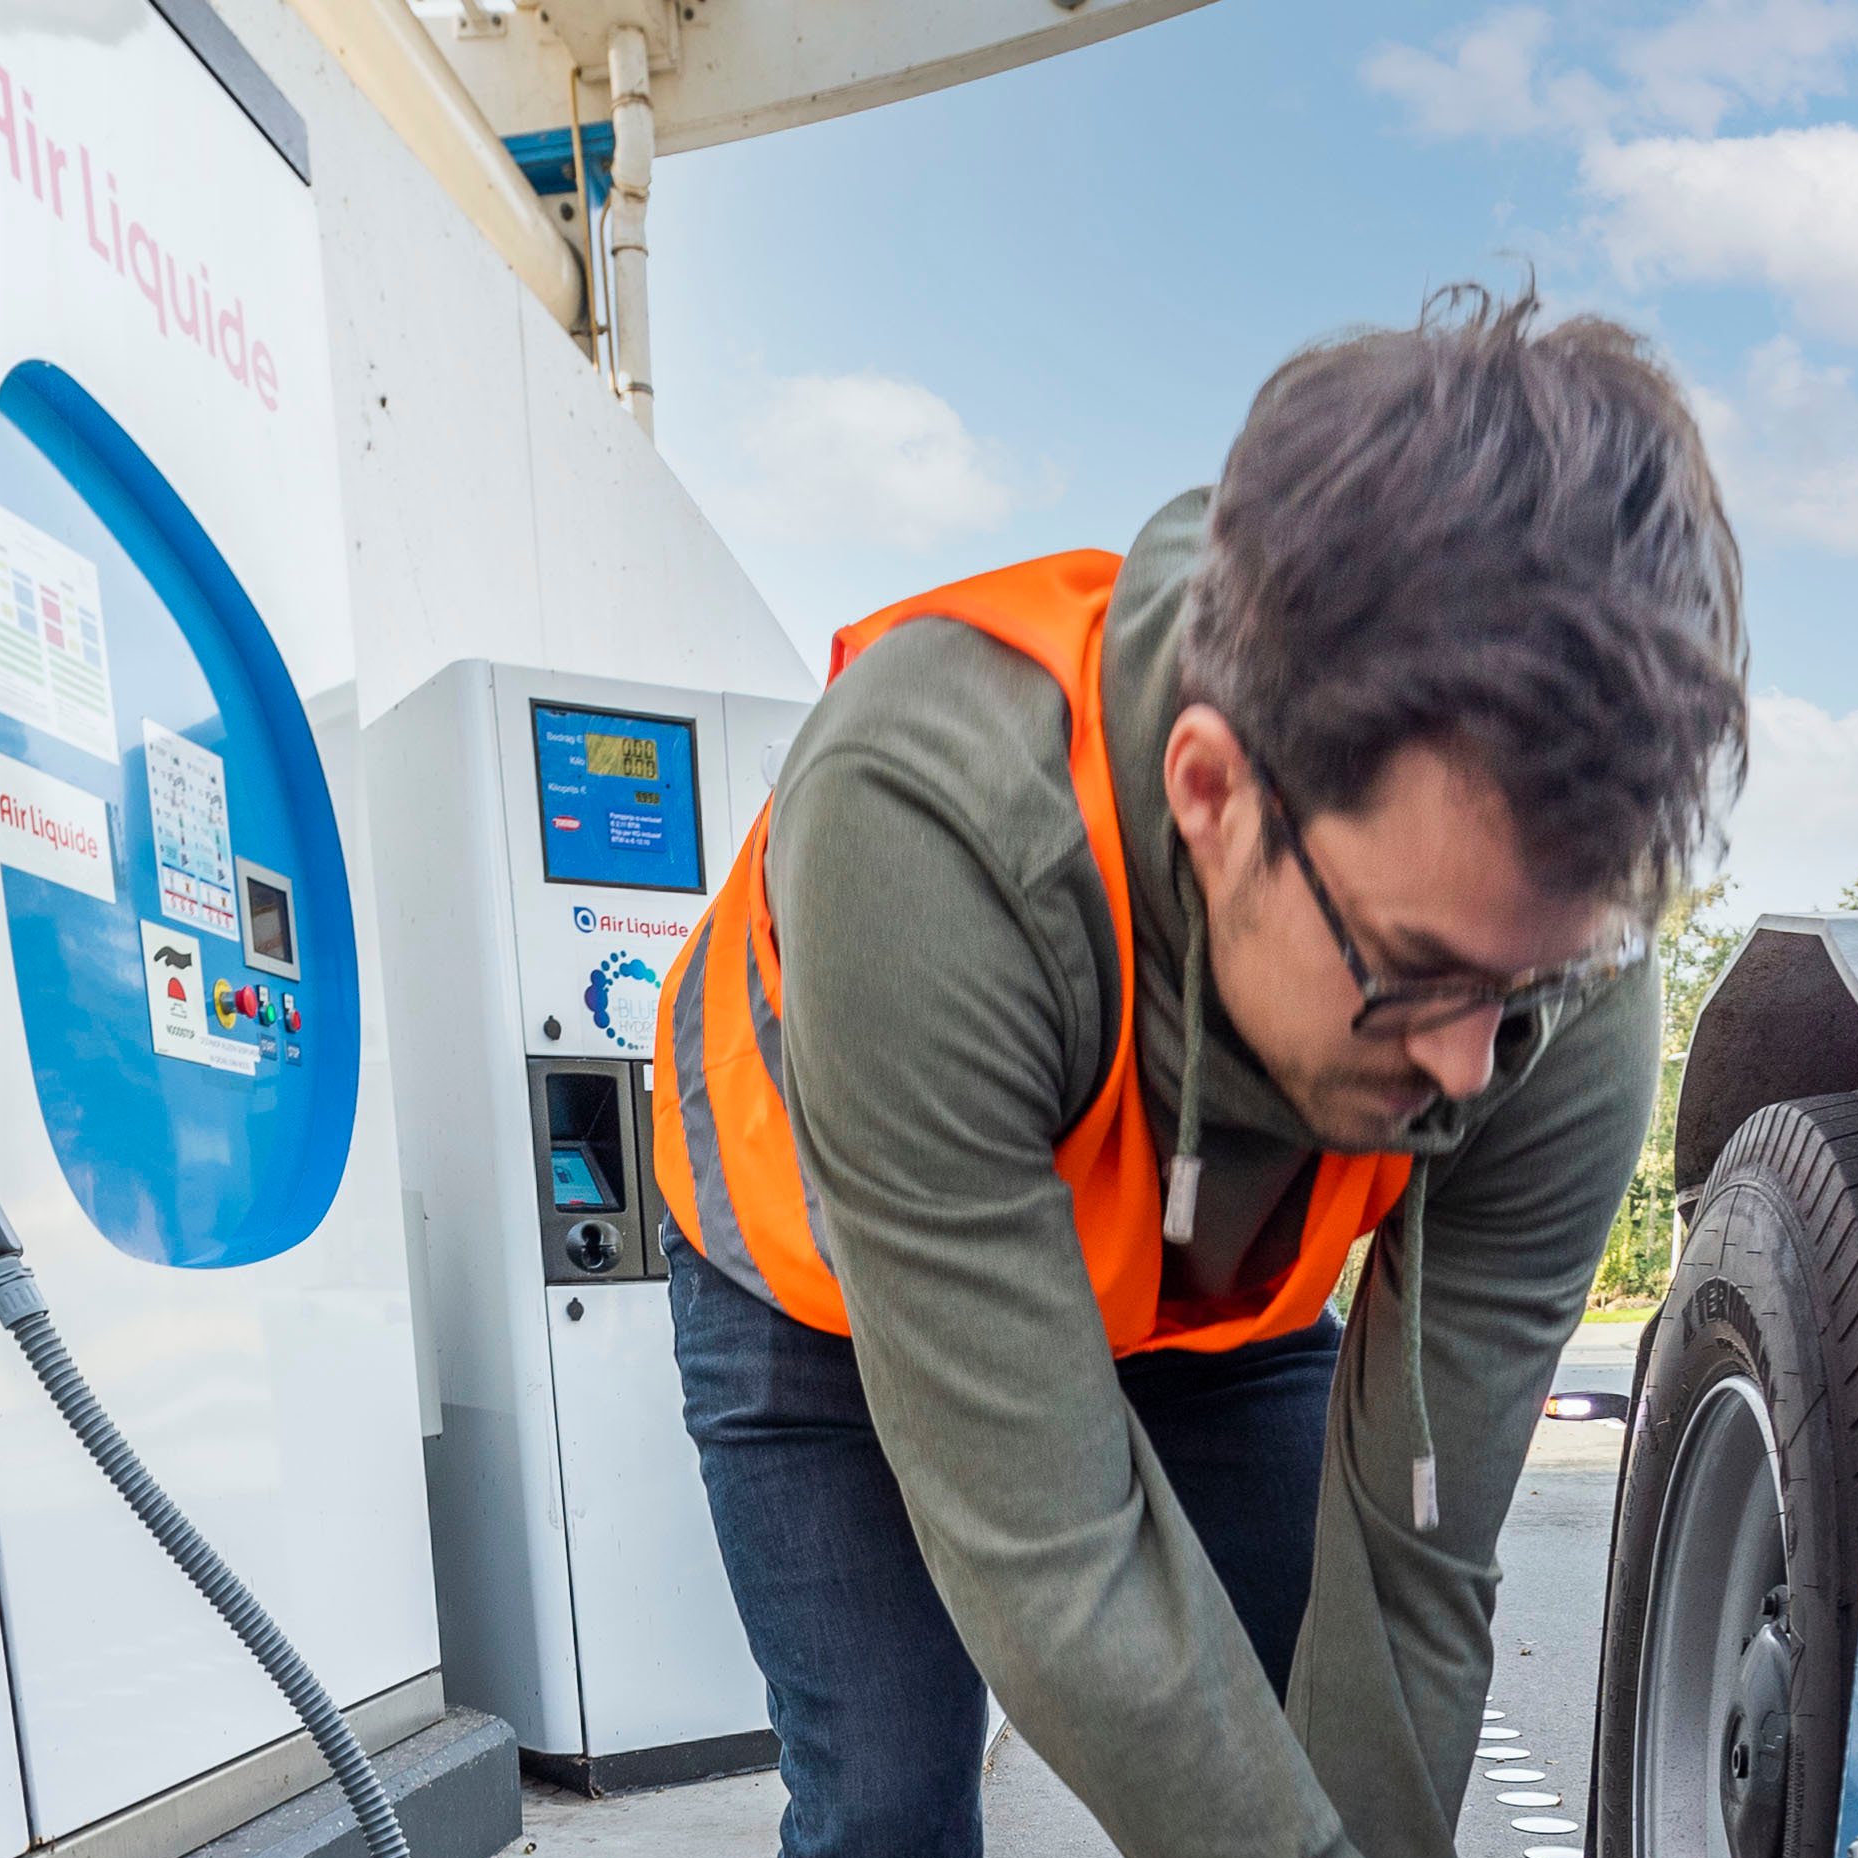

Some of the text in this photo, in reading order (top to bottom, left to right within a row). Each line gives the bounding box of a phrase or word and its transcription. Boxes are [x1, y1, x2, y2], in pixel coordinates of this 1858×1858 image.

[79, 143, 279, 412] Liquide
[0, 793, 98, 859] Air Liquide
[600, 916, 689, 938] Air Liquide
